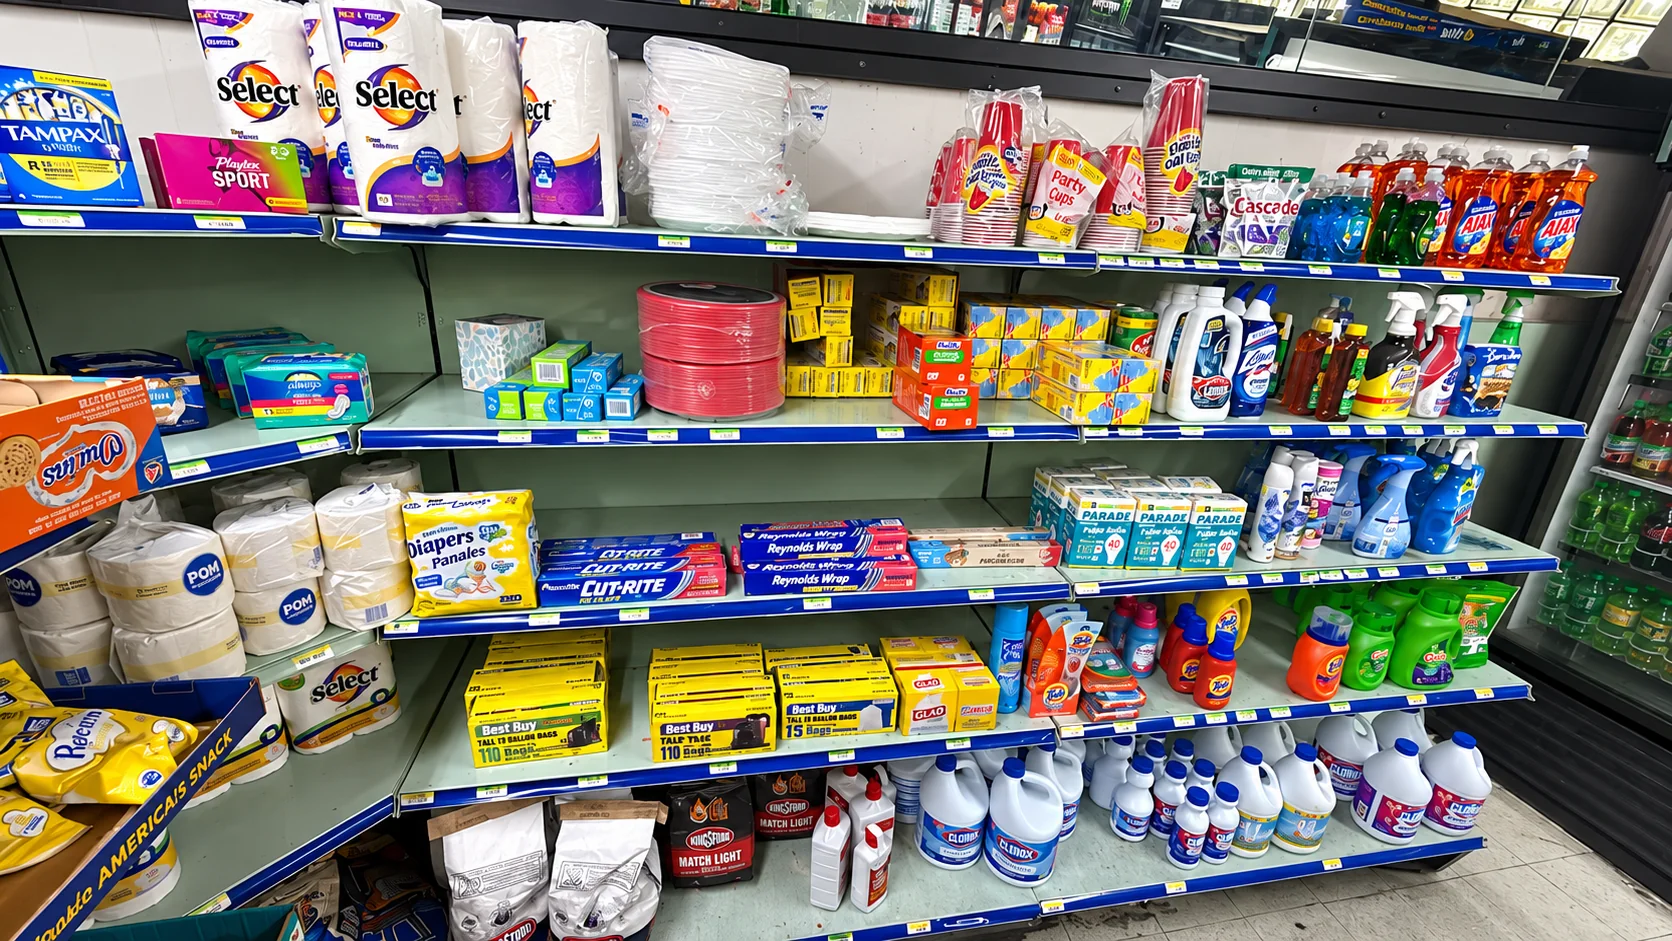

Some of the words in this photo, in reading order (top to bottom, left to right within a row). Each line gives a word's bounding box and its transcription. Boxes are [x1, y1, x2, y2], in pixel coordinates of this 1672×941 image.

[217, 77, 300, 106] Select
[356, 81, 438, 111] Select
[1, 125, 106, 144] TAMPAX
[212, 171, 270, 189] SPORT
[1052, 170, 1087, 195] Party
[1049, 187, 1075, 206] Cups
[1234, 197, 1299, 215] Cascade
[1081, 511, 1131, 520] PARADE
[1140, 513, 1187, 522] PARADE
[1196, 515, 1242, 524] PARADE
[407, 531, 474, 559] Diapers
[767, 543, 814, 555] Reynolds
[432, 546, 486, 569] Panales
[187, 560, 220, 585] POM
[772, 574, 820, 587] Reynolds
[822, 574, 850, 584] Wrap
[5, 577, 35, 591] POM
[283, 594, 313, 616] POM
[311, 665, 379, 703] Select
[792, 703, 816, 714] Best
[817, 703, 837, 713] Buy
[482, 722, 510, 736] Best
[512, 721, 537, 733] Buy
[665, 724, 691, 735] Best
[692, 722, 714, 732] Buy
[189, 727, 233, 787] SNACK
[478, 746, 500, 763] 110
[660, 745, 681, 760] 110
[760, 818, 788, 828] MATCH
[790, 815, 813, 828] LIGHT
[679, 854, 712, 867] MATCH
[714, 849, 742, 864] LIGHT
